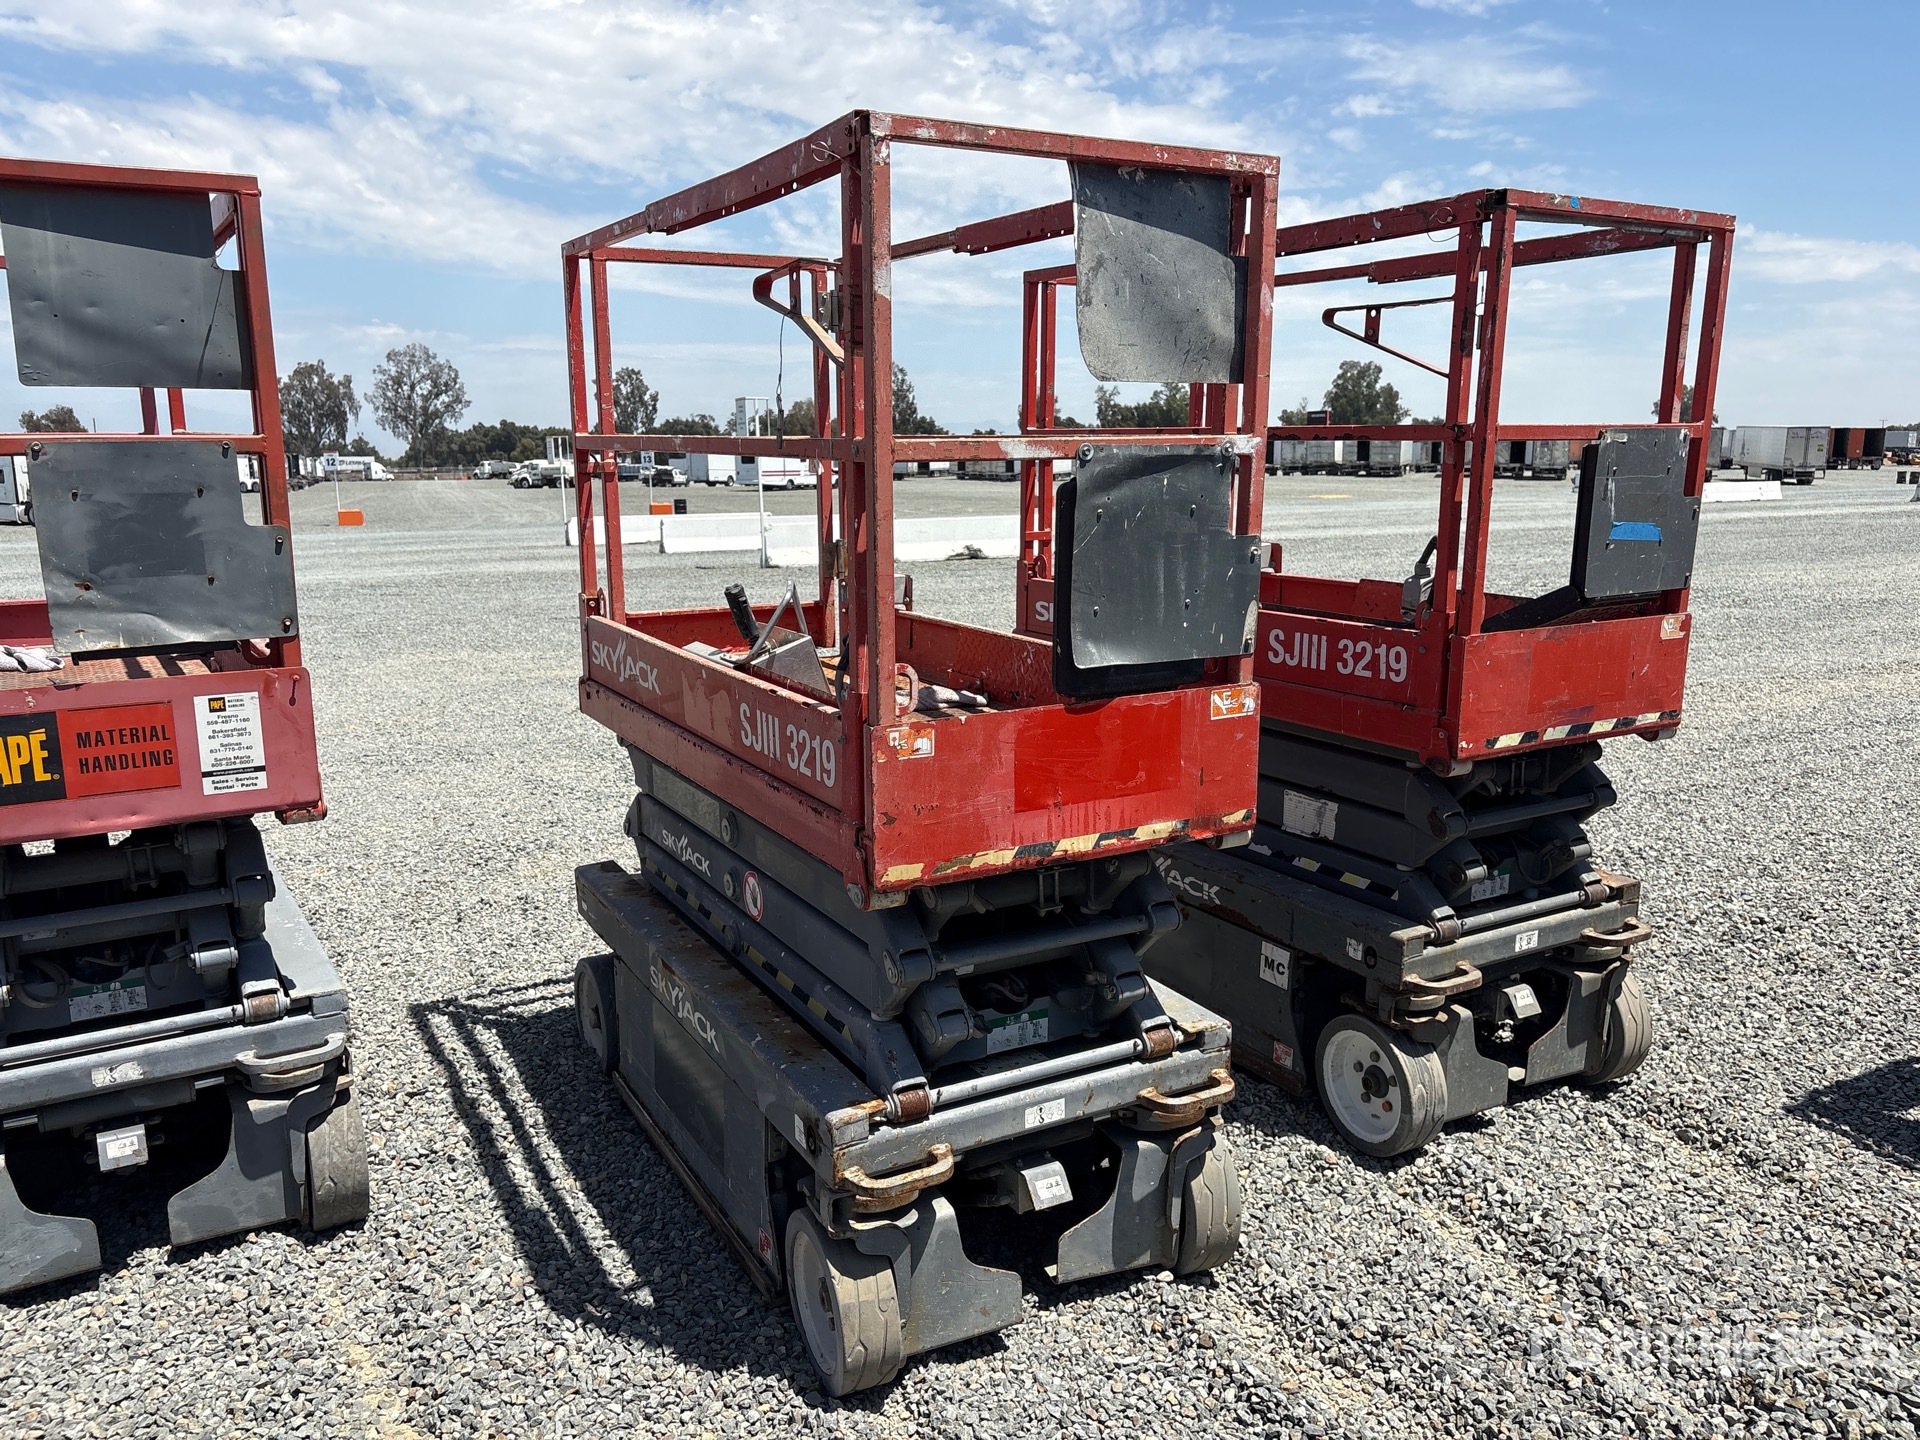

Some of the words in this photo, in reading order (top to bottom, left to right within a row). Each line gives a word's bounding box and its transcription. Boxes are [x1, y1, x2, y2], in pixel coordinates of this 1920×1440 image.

[326, 458, 336, 466] 12
[591, 637, 662, 696] SKYJACK
[1267, 628, 1327, 671] SJIII
[1336, 638, 1407, 683] 3219
[206, 717, 250, 726] 559-487-1160
[212, 726, 247, 735] Bakersfield
[76, 724, 171, 749] MATERIAL
[740, 702, 781, 762] SJIII
[786, 723, 836, 788] 3219
[78, 749, 174, 774] HANDLING
[209, 745, 253, 754] 831-775-0140
[662, 829, 711, 878] SKYJACK
[1264, 955, 1286, 976] MC
[650, 965, 720, 1053] SKYJACK
